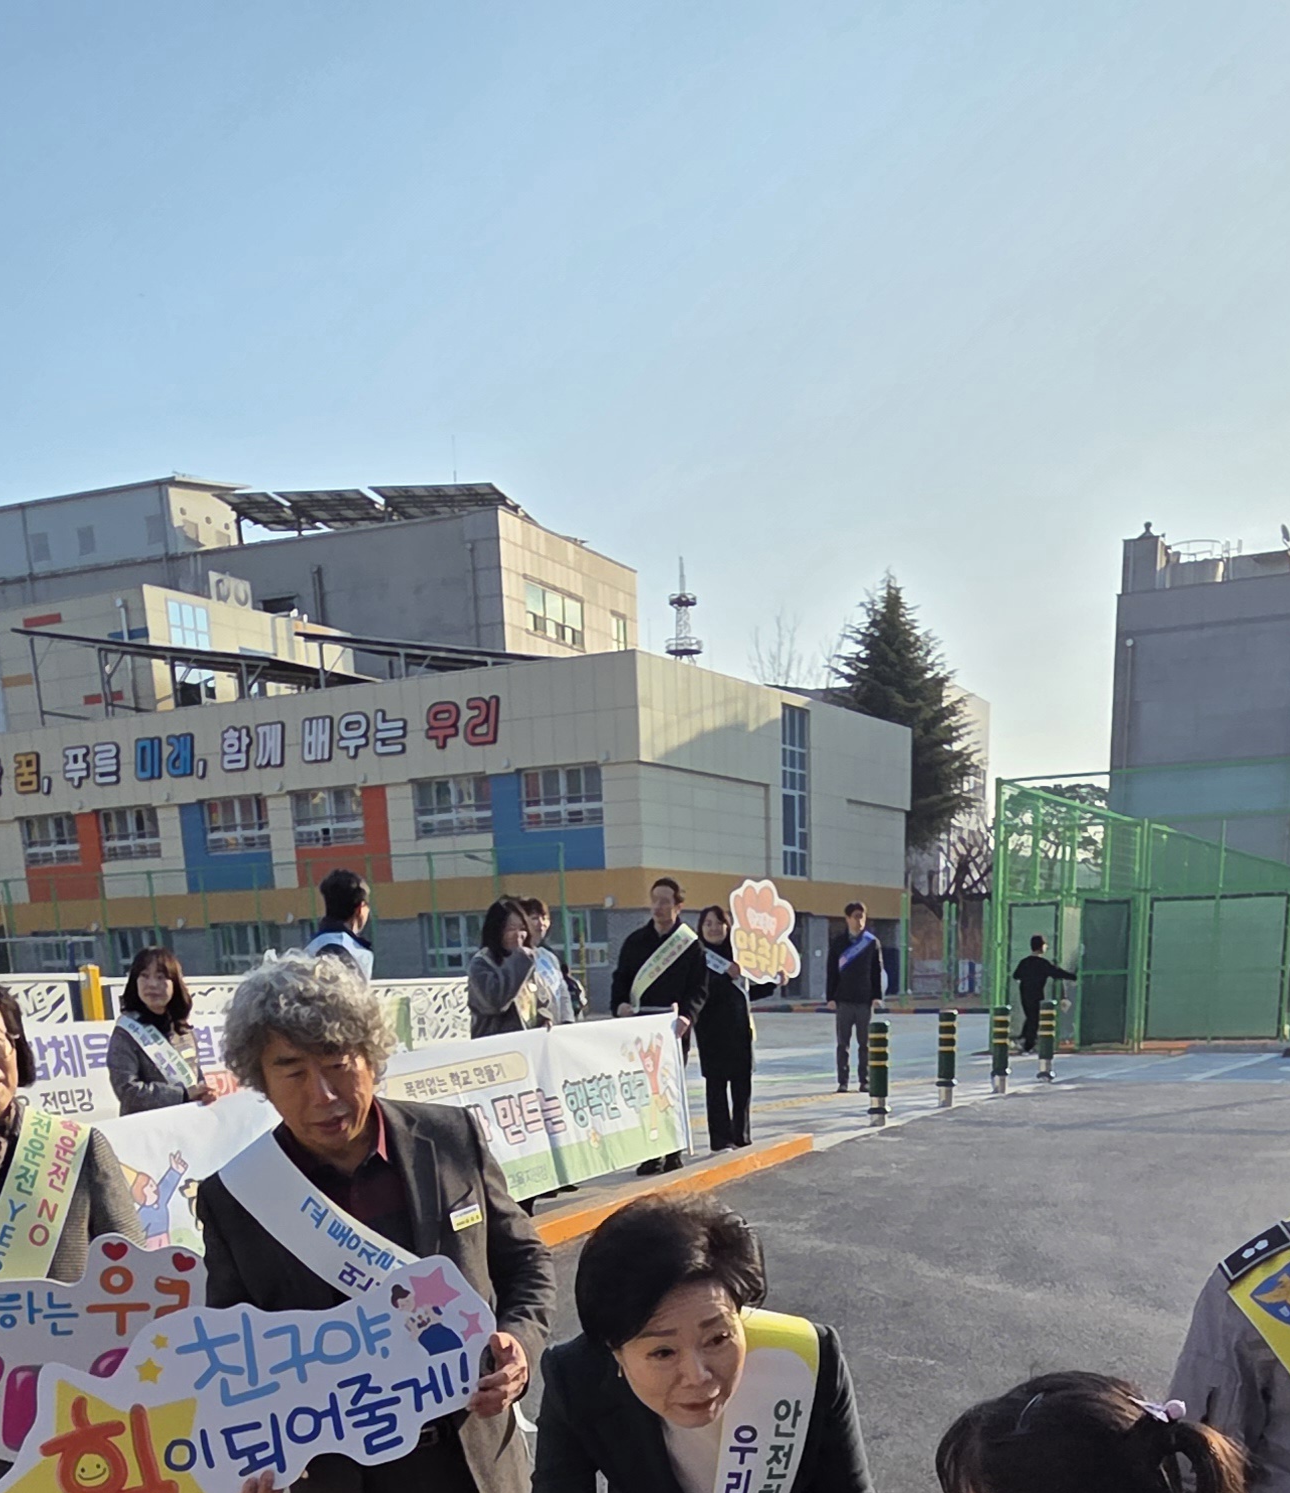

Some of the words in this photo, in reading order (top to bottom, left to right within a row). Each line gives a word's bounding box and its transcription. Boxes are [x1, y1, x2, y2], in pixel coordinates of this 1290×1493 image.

[13, 750, 51, 796] 꿈,
[62, 742, 120, 788] 푸른
[133, 732, 207, 781] 미래,
[220, 720, 285, 772] 함께
[301, 709, 409, 763] 배우는
[424, 694, 501, 748] 우리
[491, 1087, 567, 1146] 만드는
[562, 1073, 621, 1128] 행복한
[27, 1198, 59, 1248] NO
[299, 1196, 412, 1272] 교통질
[338, 1261, 381, 1293] 먼
